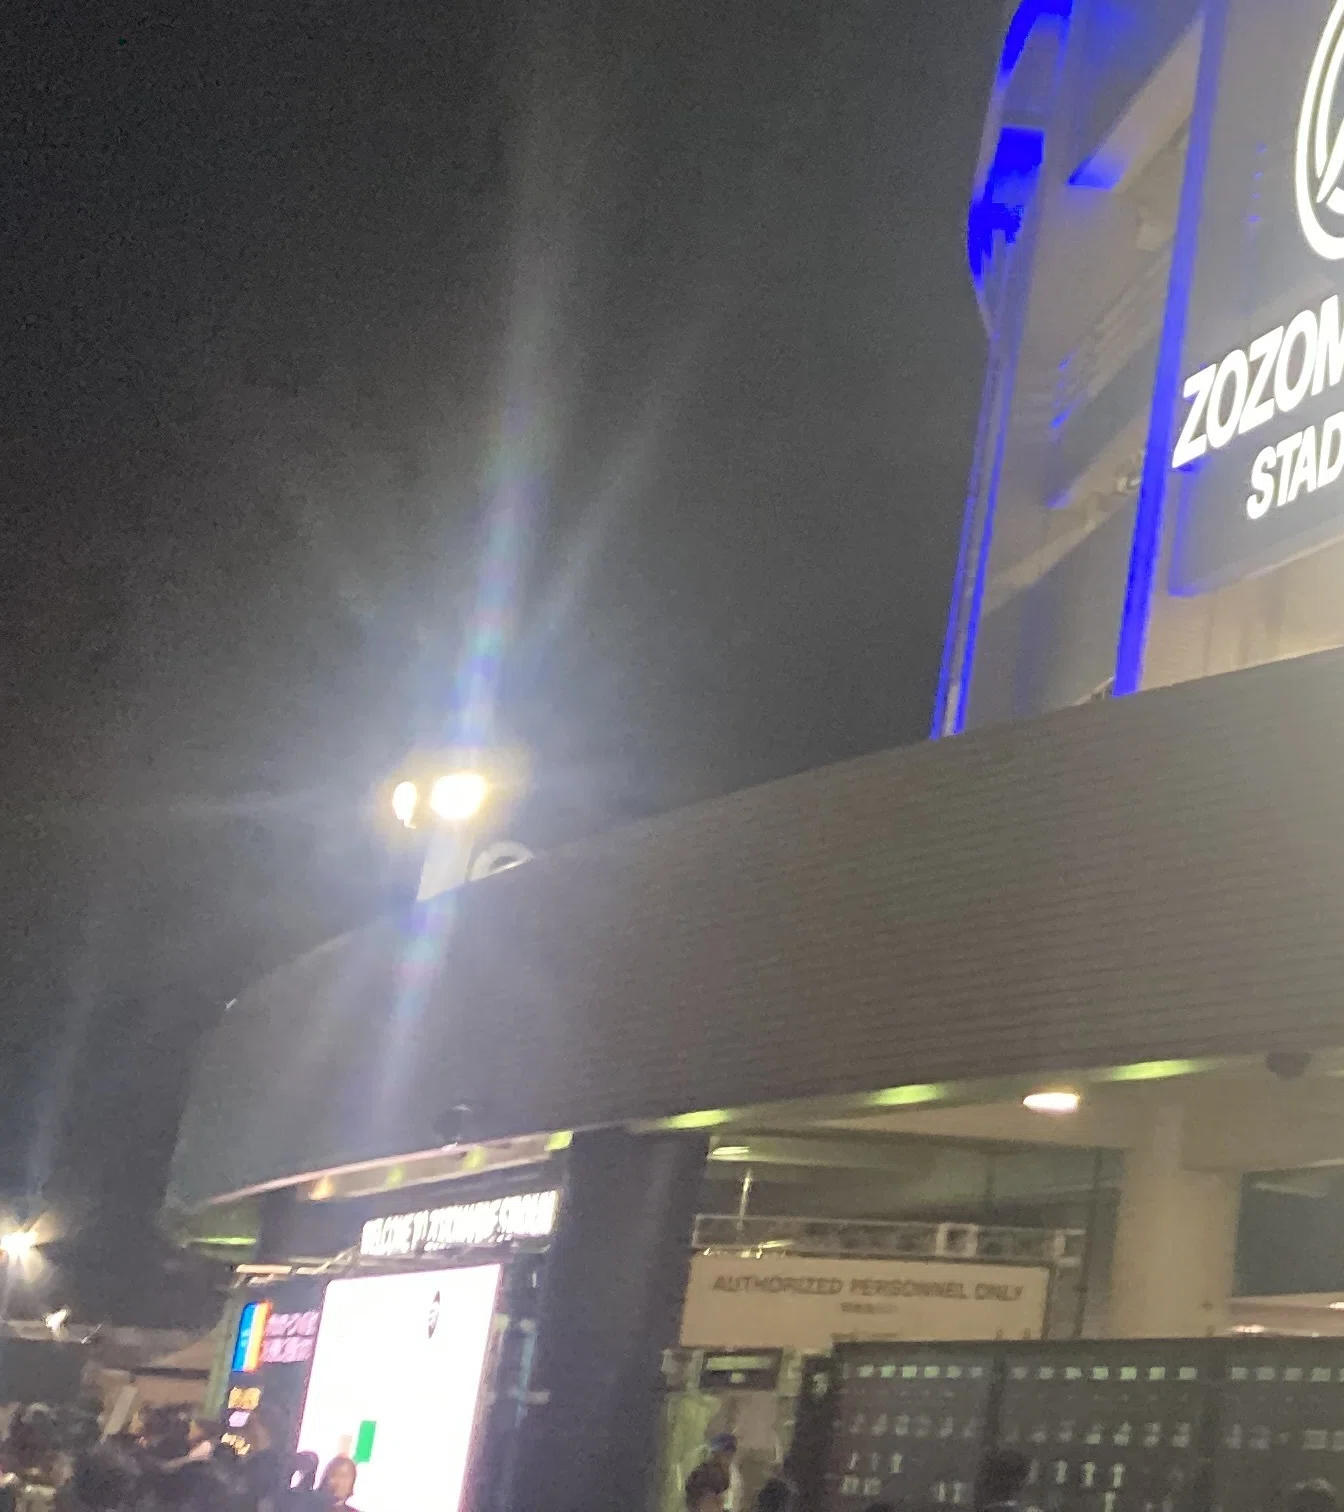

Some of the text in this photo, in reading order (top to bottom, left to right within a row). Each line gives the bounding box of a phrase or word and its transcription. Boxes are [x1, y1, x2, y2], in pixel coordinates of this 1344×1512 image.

[712, 1275, 1025, 1302] AUTHORIZED PERSONNEL ONLY
